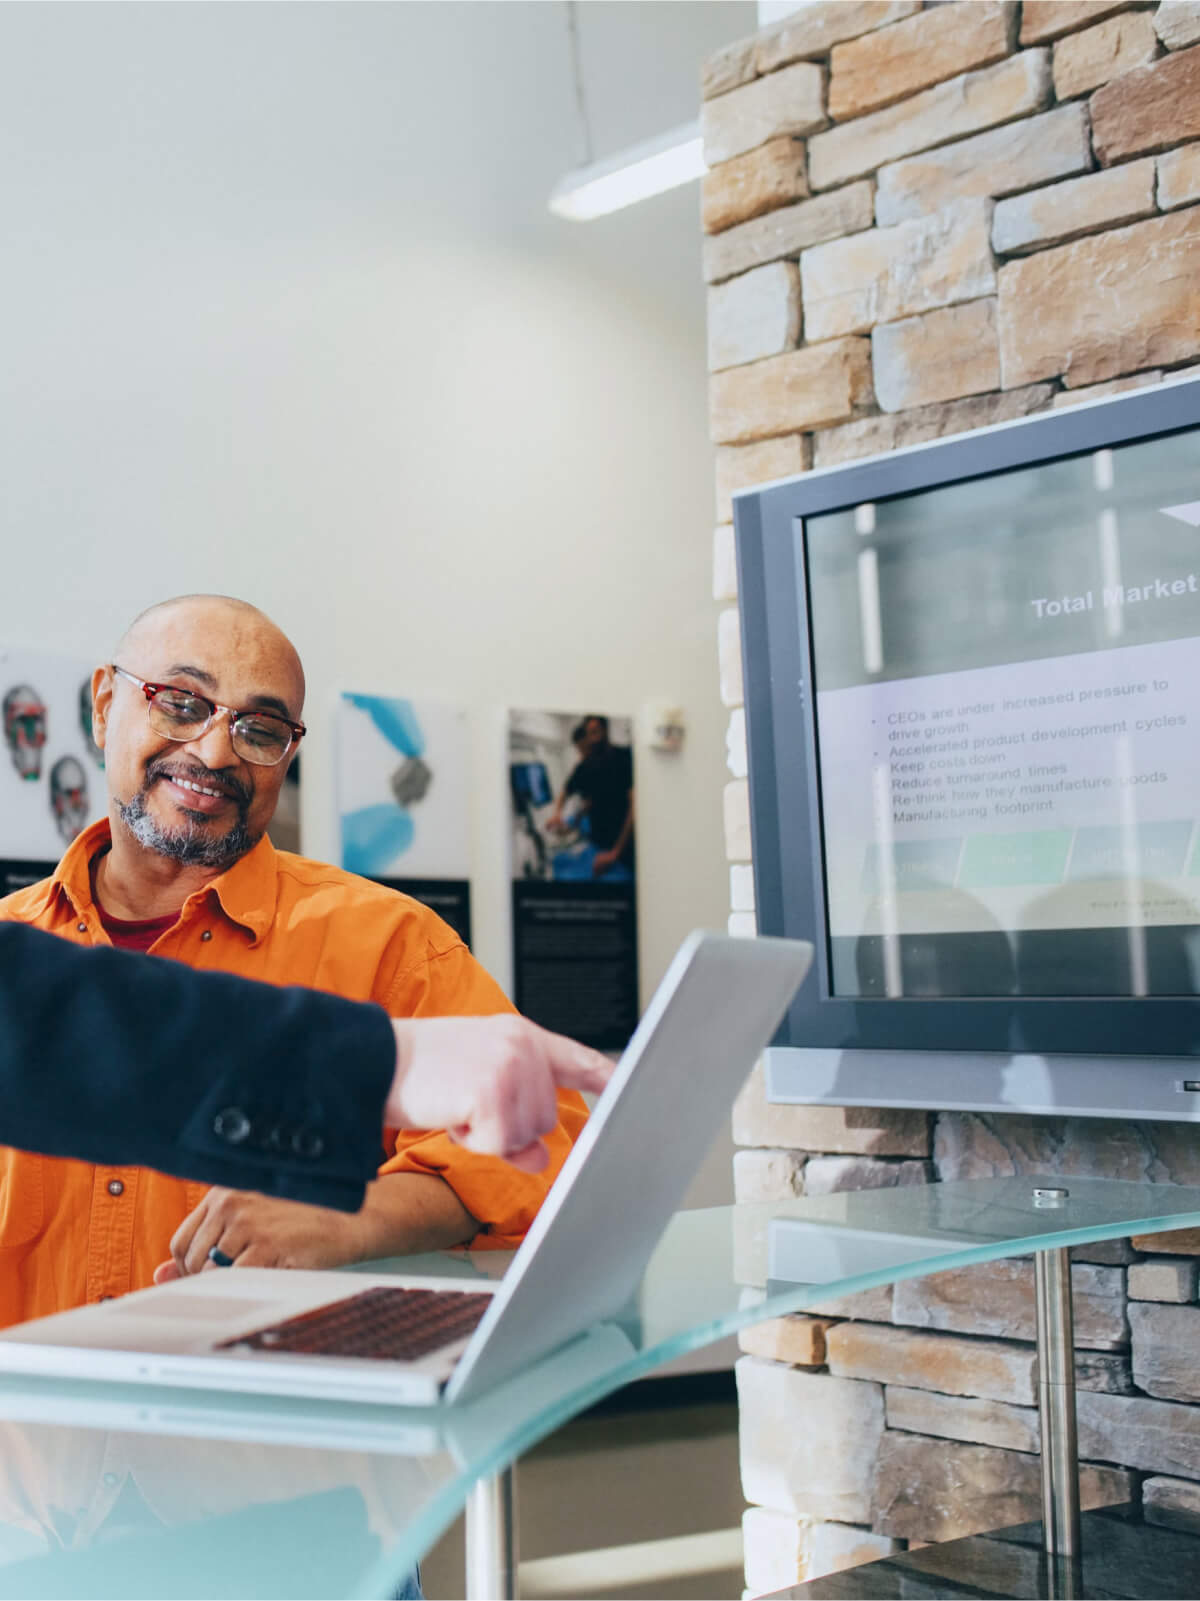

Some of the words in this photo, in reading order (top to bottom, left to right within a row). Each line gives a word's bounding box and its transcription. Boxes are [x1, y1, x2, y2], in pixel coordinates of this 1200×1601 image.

[1031, 591, 1093, 618] Total
[1102, 574, 1197, 608] Market
[887, 711, 926, 725] CEOs
[931, 709, 953, 719] are
[957, 702, 995, 715] under
[1002, 692, 1074, 711] increased
[1079, 682, 1148, 702] pressure
[1152, 679, 1169, 691] to
[888, 728, 920, 741] drive
[924, 722, 969, 739] growth
[889, 739, 968, 758] Accelerated
[973, 732, 1025, 751] product
[1031, 720, 1127, 742] development
[1135, 714, 1187, 731] cycles
[890, 761, 925, 774] Keep
[929, 757, 967, 770] costs
[969, 753, 1006, 766] down
[891, 776, 942, 790] Reduce
[947, 767, 1020, 785] turnaround
[1028, 763, 1067, 777] times
[985, 784, 1016, 799] they
[1020, 776, 1112, 794] manufacture
[994, 799, 1054, 816] footprint
